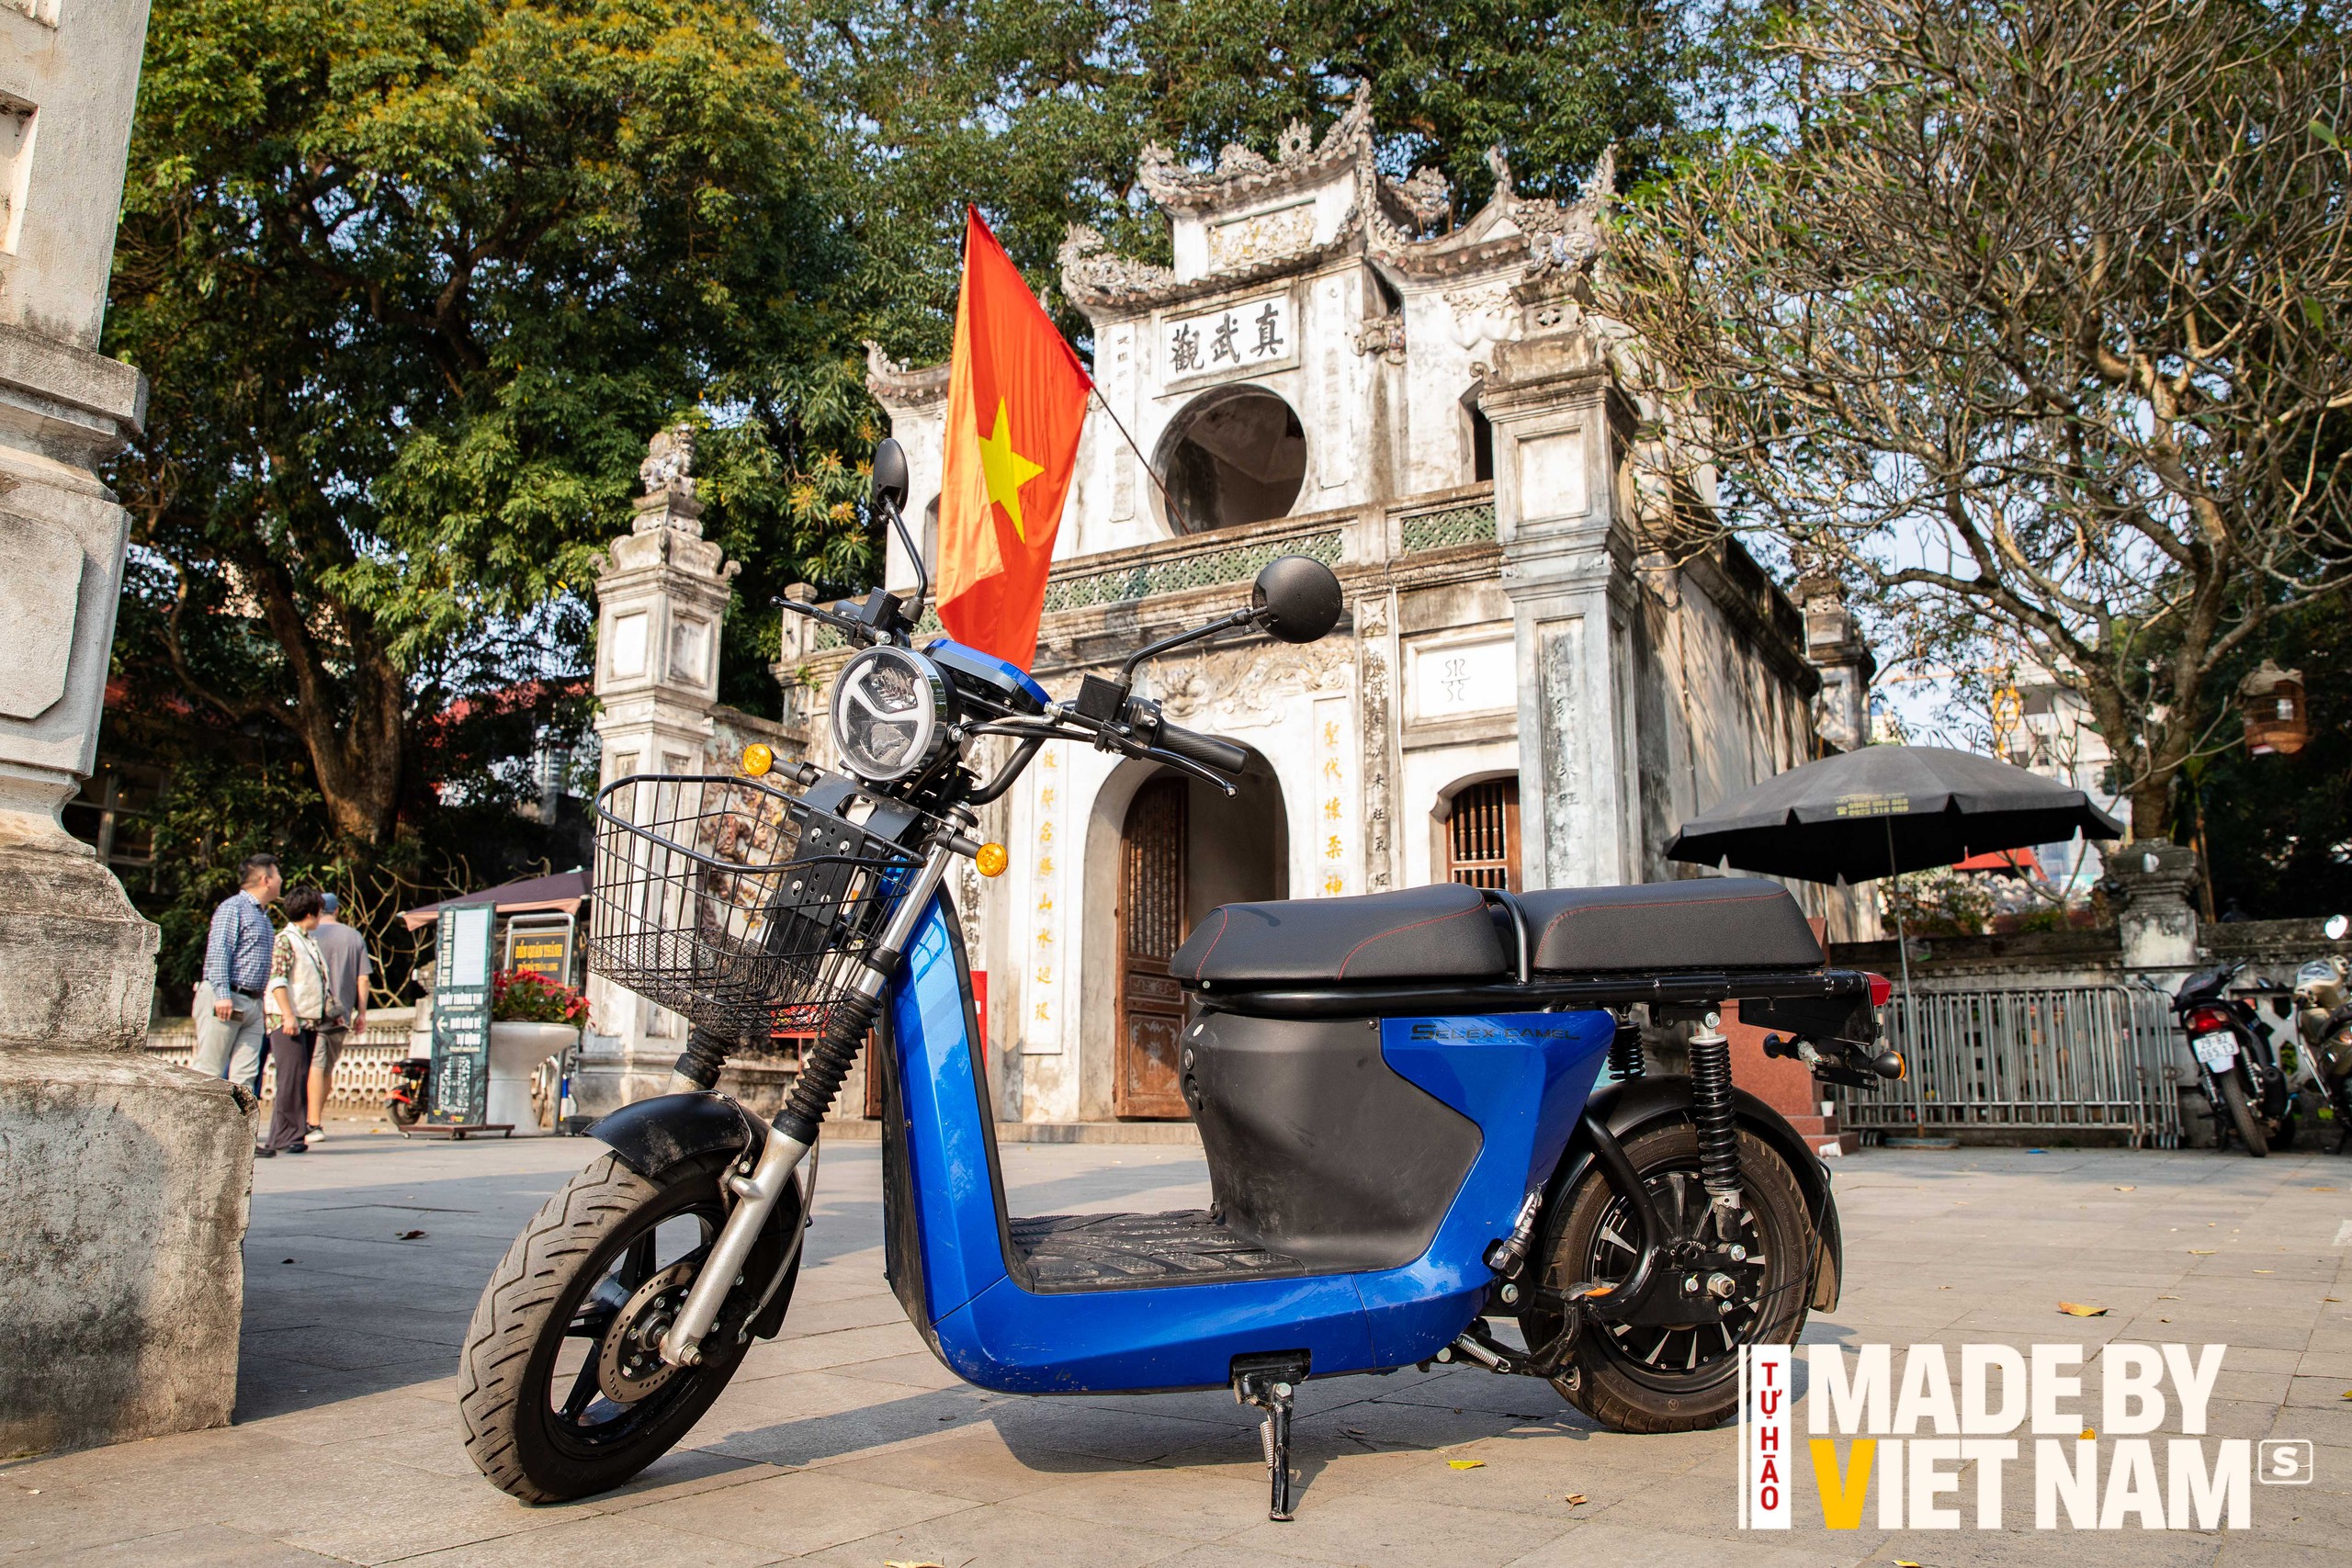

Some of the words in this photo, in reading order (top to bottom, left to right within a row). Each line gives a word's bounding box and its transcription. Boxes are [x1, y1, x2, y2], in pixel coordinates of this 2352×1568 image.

[1170, 302, 1284, 374] 真武觀
[1410, 1024, 1496, 1041] SELEX
[1505, 1027, 1581, 1041] CAMEL
